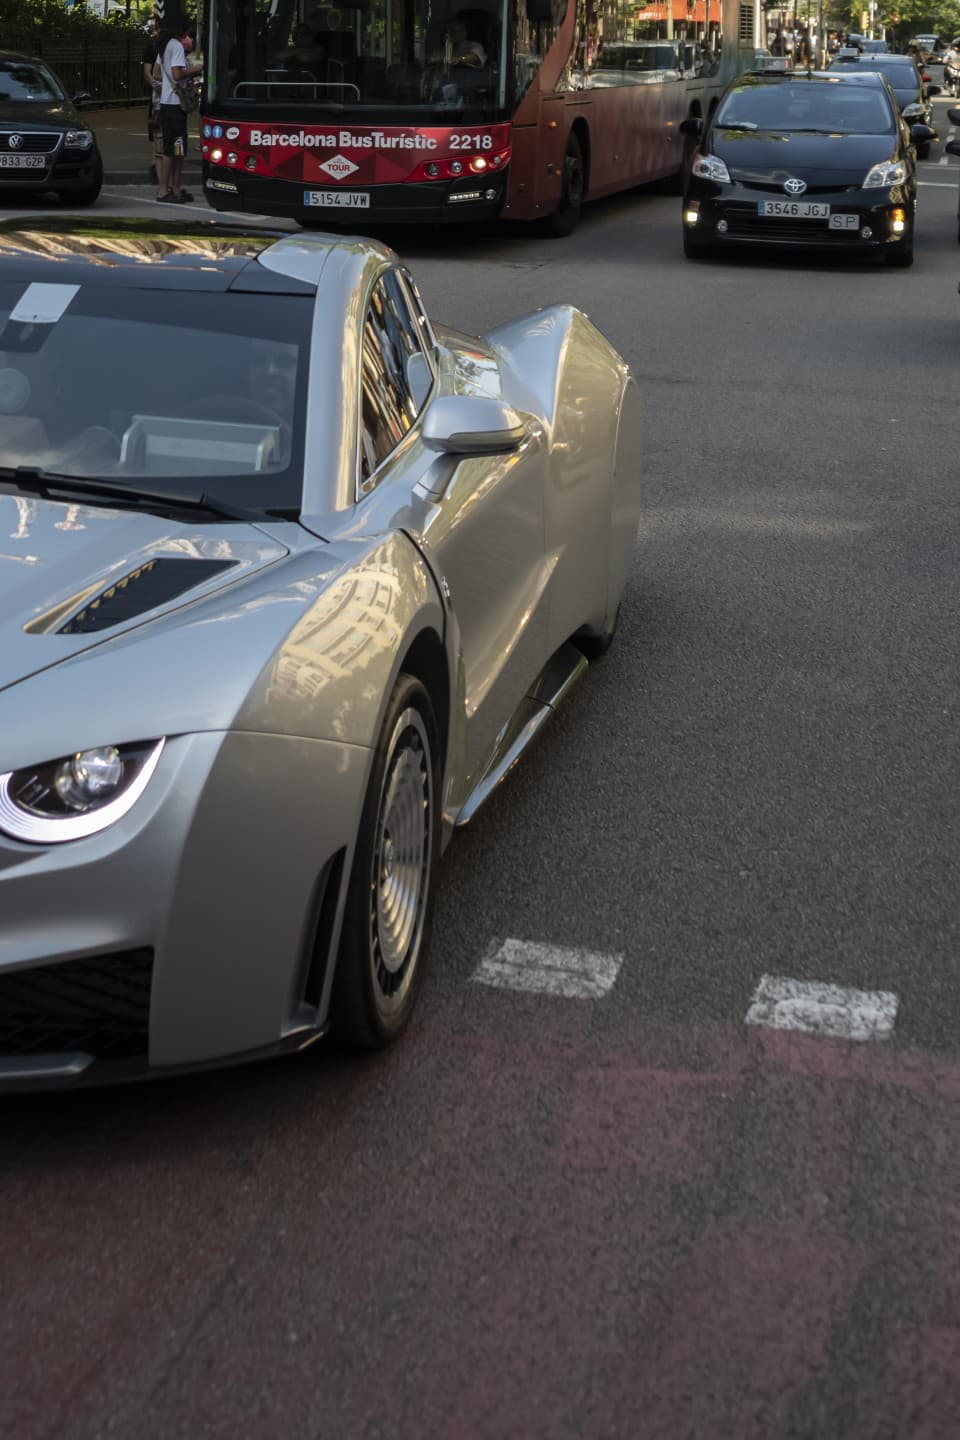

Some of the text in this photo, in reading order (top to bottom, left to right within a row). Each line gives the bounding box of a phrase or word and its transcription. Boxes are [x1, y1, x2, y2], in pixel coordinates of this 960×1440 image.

[250, 130, 337, 147] Barcelona
[449, 135, 493, 150] 2218
[25, 157, 43, 167] GZP
[327, 163, 350, 173] TOUR
[311, 192, 368, 207] 5154 JVW
[767, 202, 828, 217] 3546 JGJ
